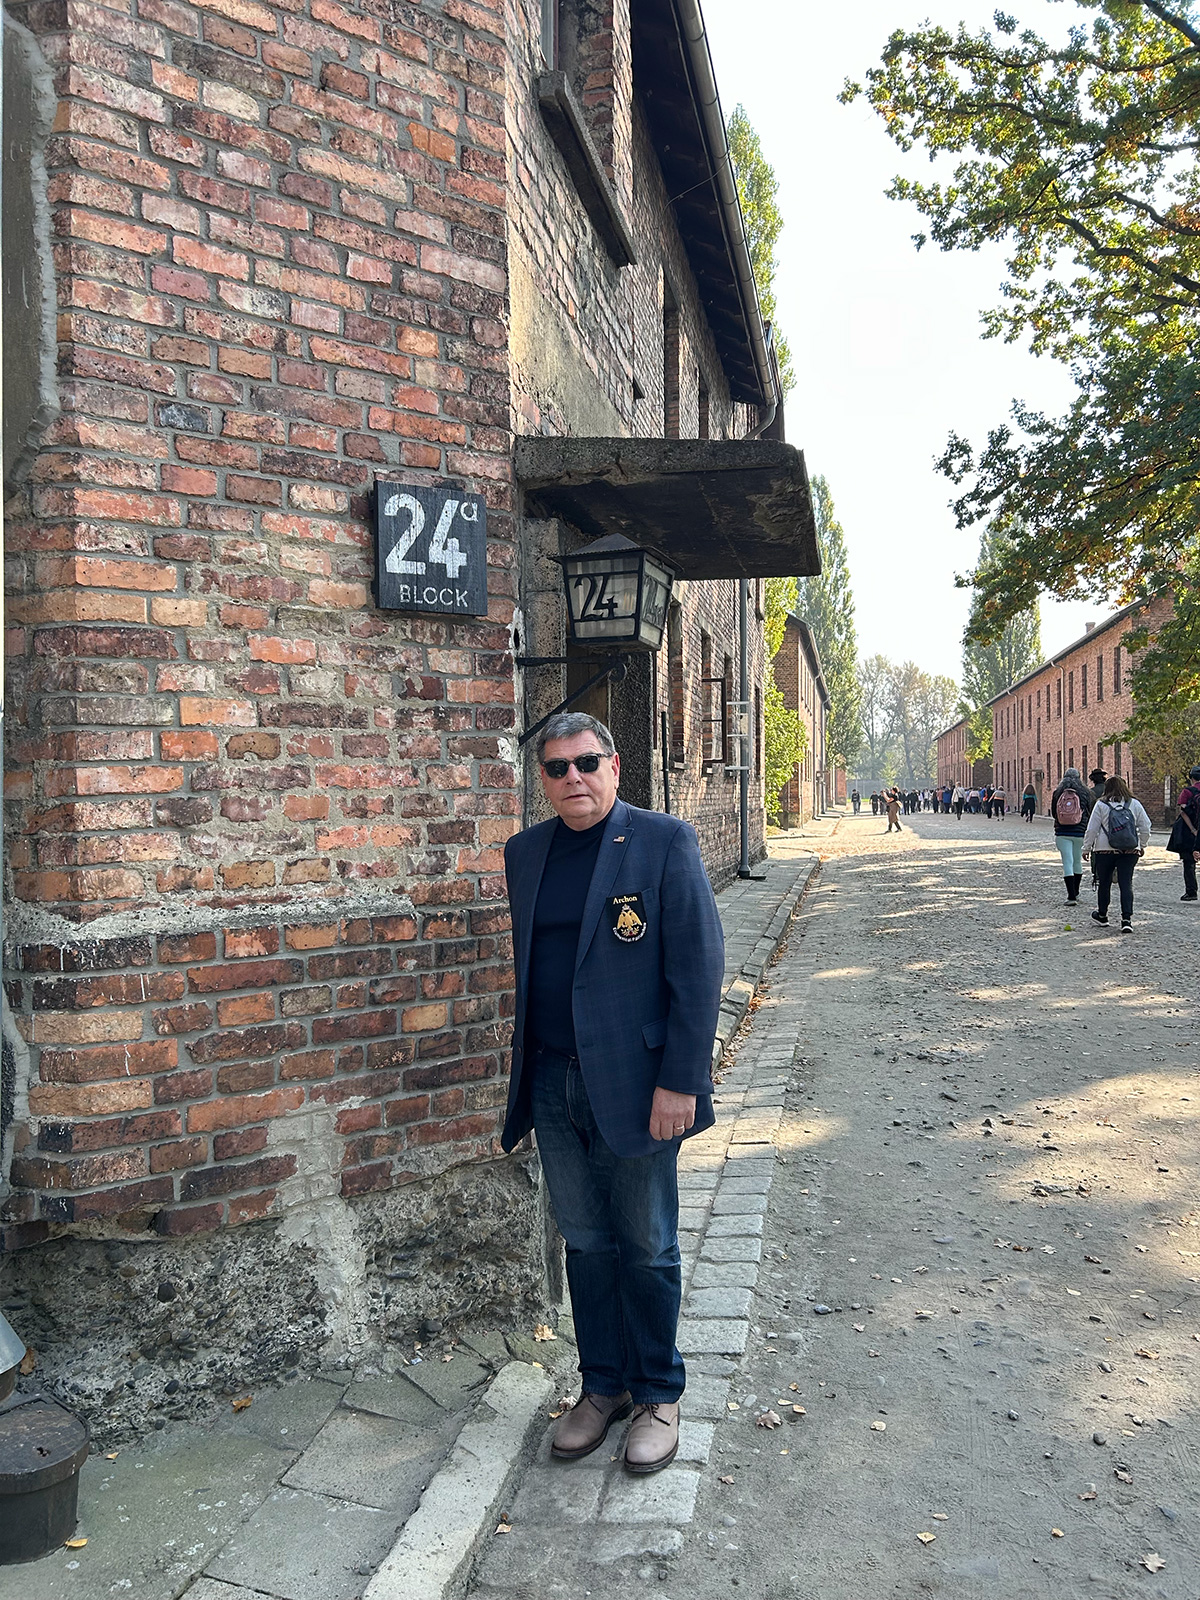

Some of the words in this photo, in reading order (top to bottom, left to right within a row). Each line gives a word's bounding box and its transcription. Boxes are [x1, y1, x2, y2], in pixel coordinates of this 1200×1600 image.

[399, 584, 469, 608] BLOCK
[573, 574, 619, 621] 24
[612, 895, 638, 905] Archon
